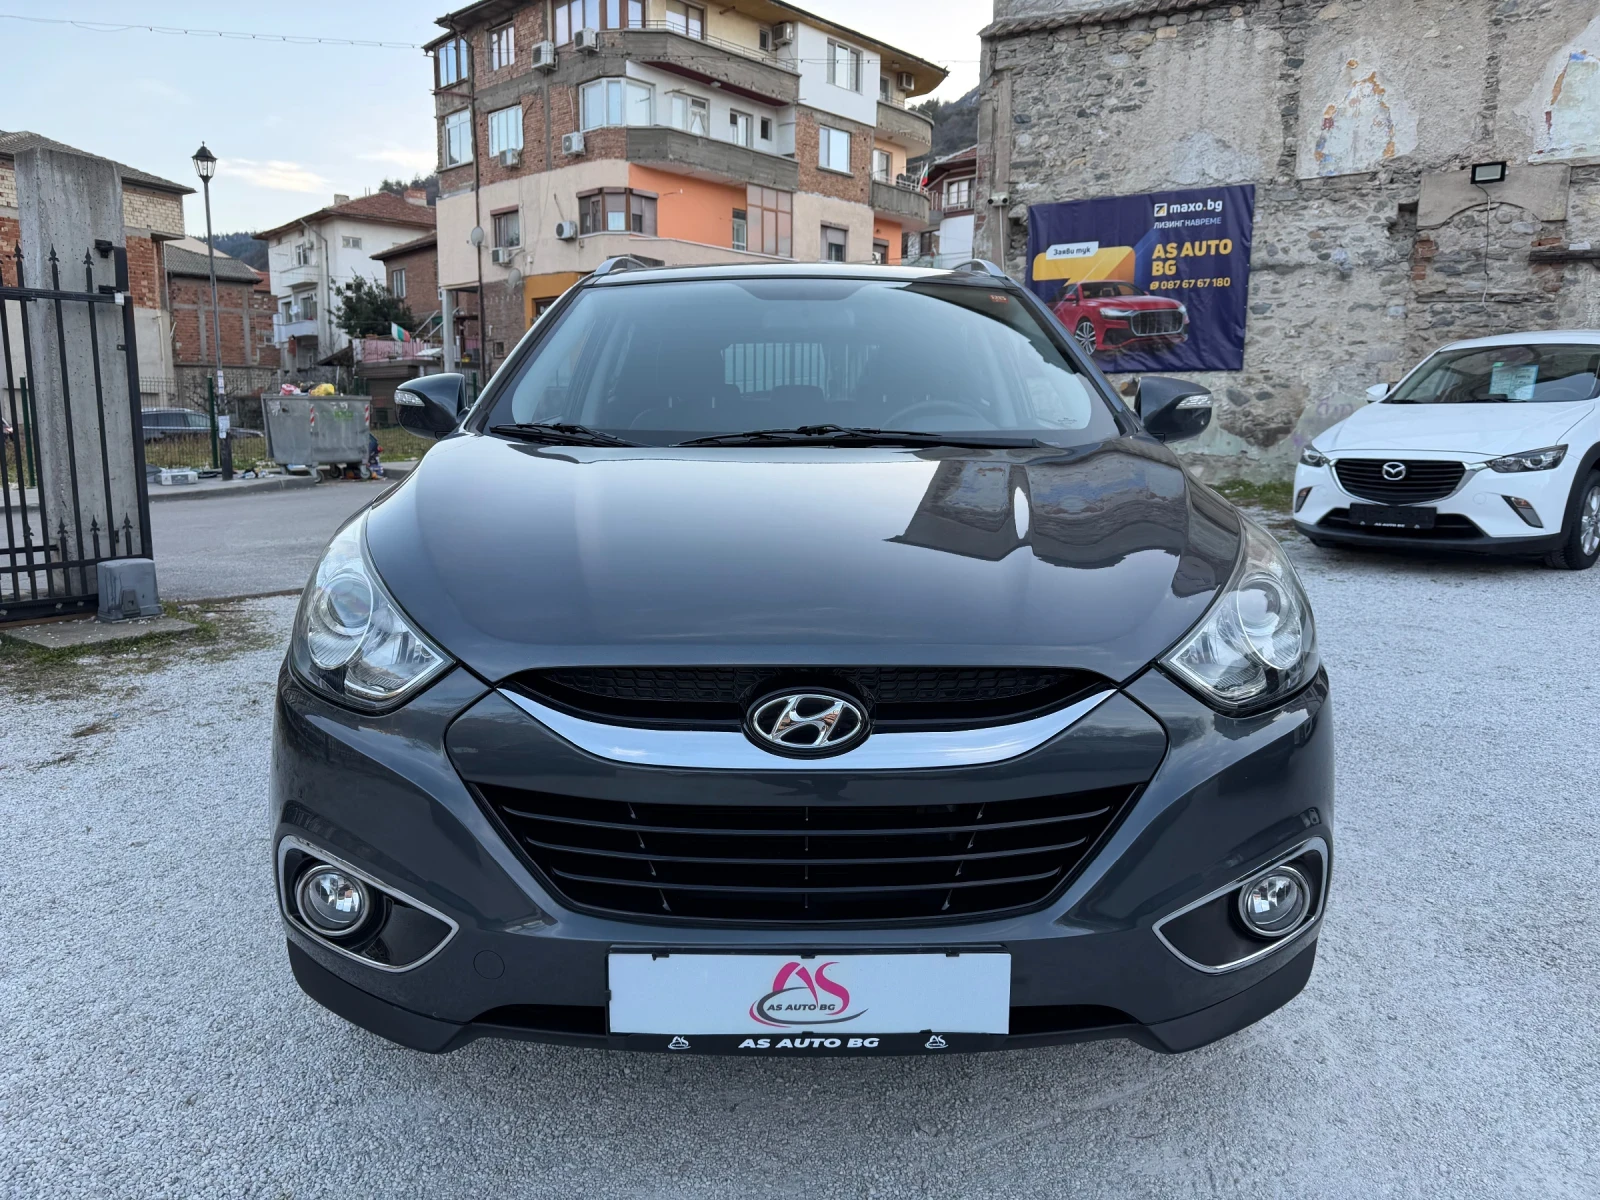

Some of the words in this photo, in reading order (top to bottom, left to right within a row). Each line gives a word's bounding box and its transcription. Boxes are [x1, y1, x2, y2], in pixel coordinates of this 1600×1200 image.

[1169, 198, 1223, 213] maxo.bg
[1153, 219, 1184, 230] ЛИЗИНГ
[1184, 216, 1222, 227] НАВРЕМЕ
[1151, 242, 1178, 259] AS
[1179, 238, 1233, 257] AUTO
[1151, 259, 1177, 276] BG
[1160, 280, 1180, 290] 087
[1182, 279, 1195, 289] 67
[1197, 278, 1210, 288] 67
[1212, 276, 1231, 287] 180
[772, 961, 850, 1016] AS
[767, 1003, 783, 1011] AS
[785, 1003, 817, 1011] AUTO
[819, 1003, 836, 1011] BG
[738, 1038, 771, 1048] AS
[775, 1038, 842, 1048] AUTO
[846, 1037, 880, 1048] BG
